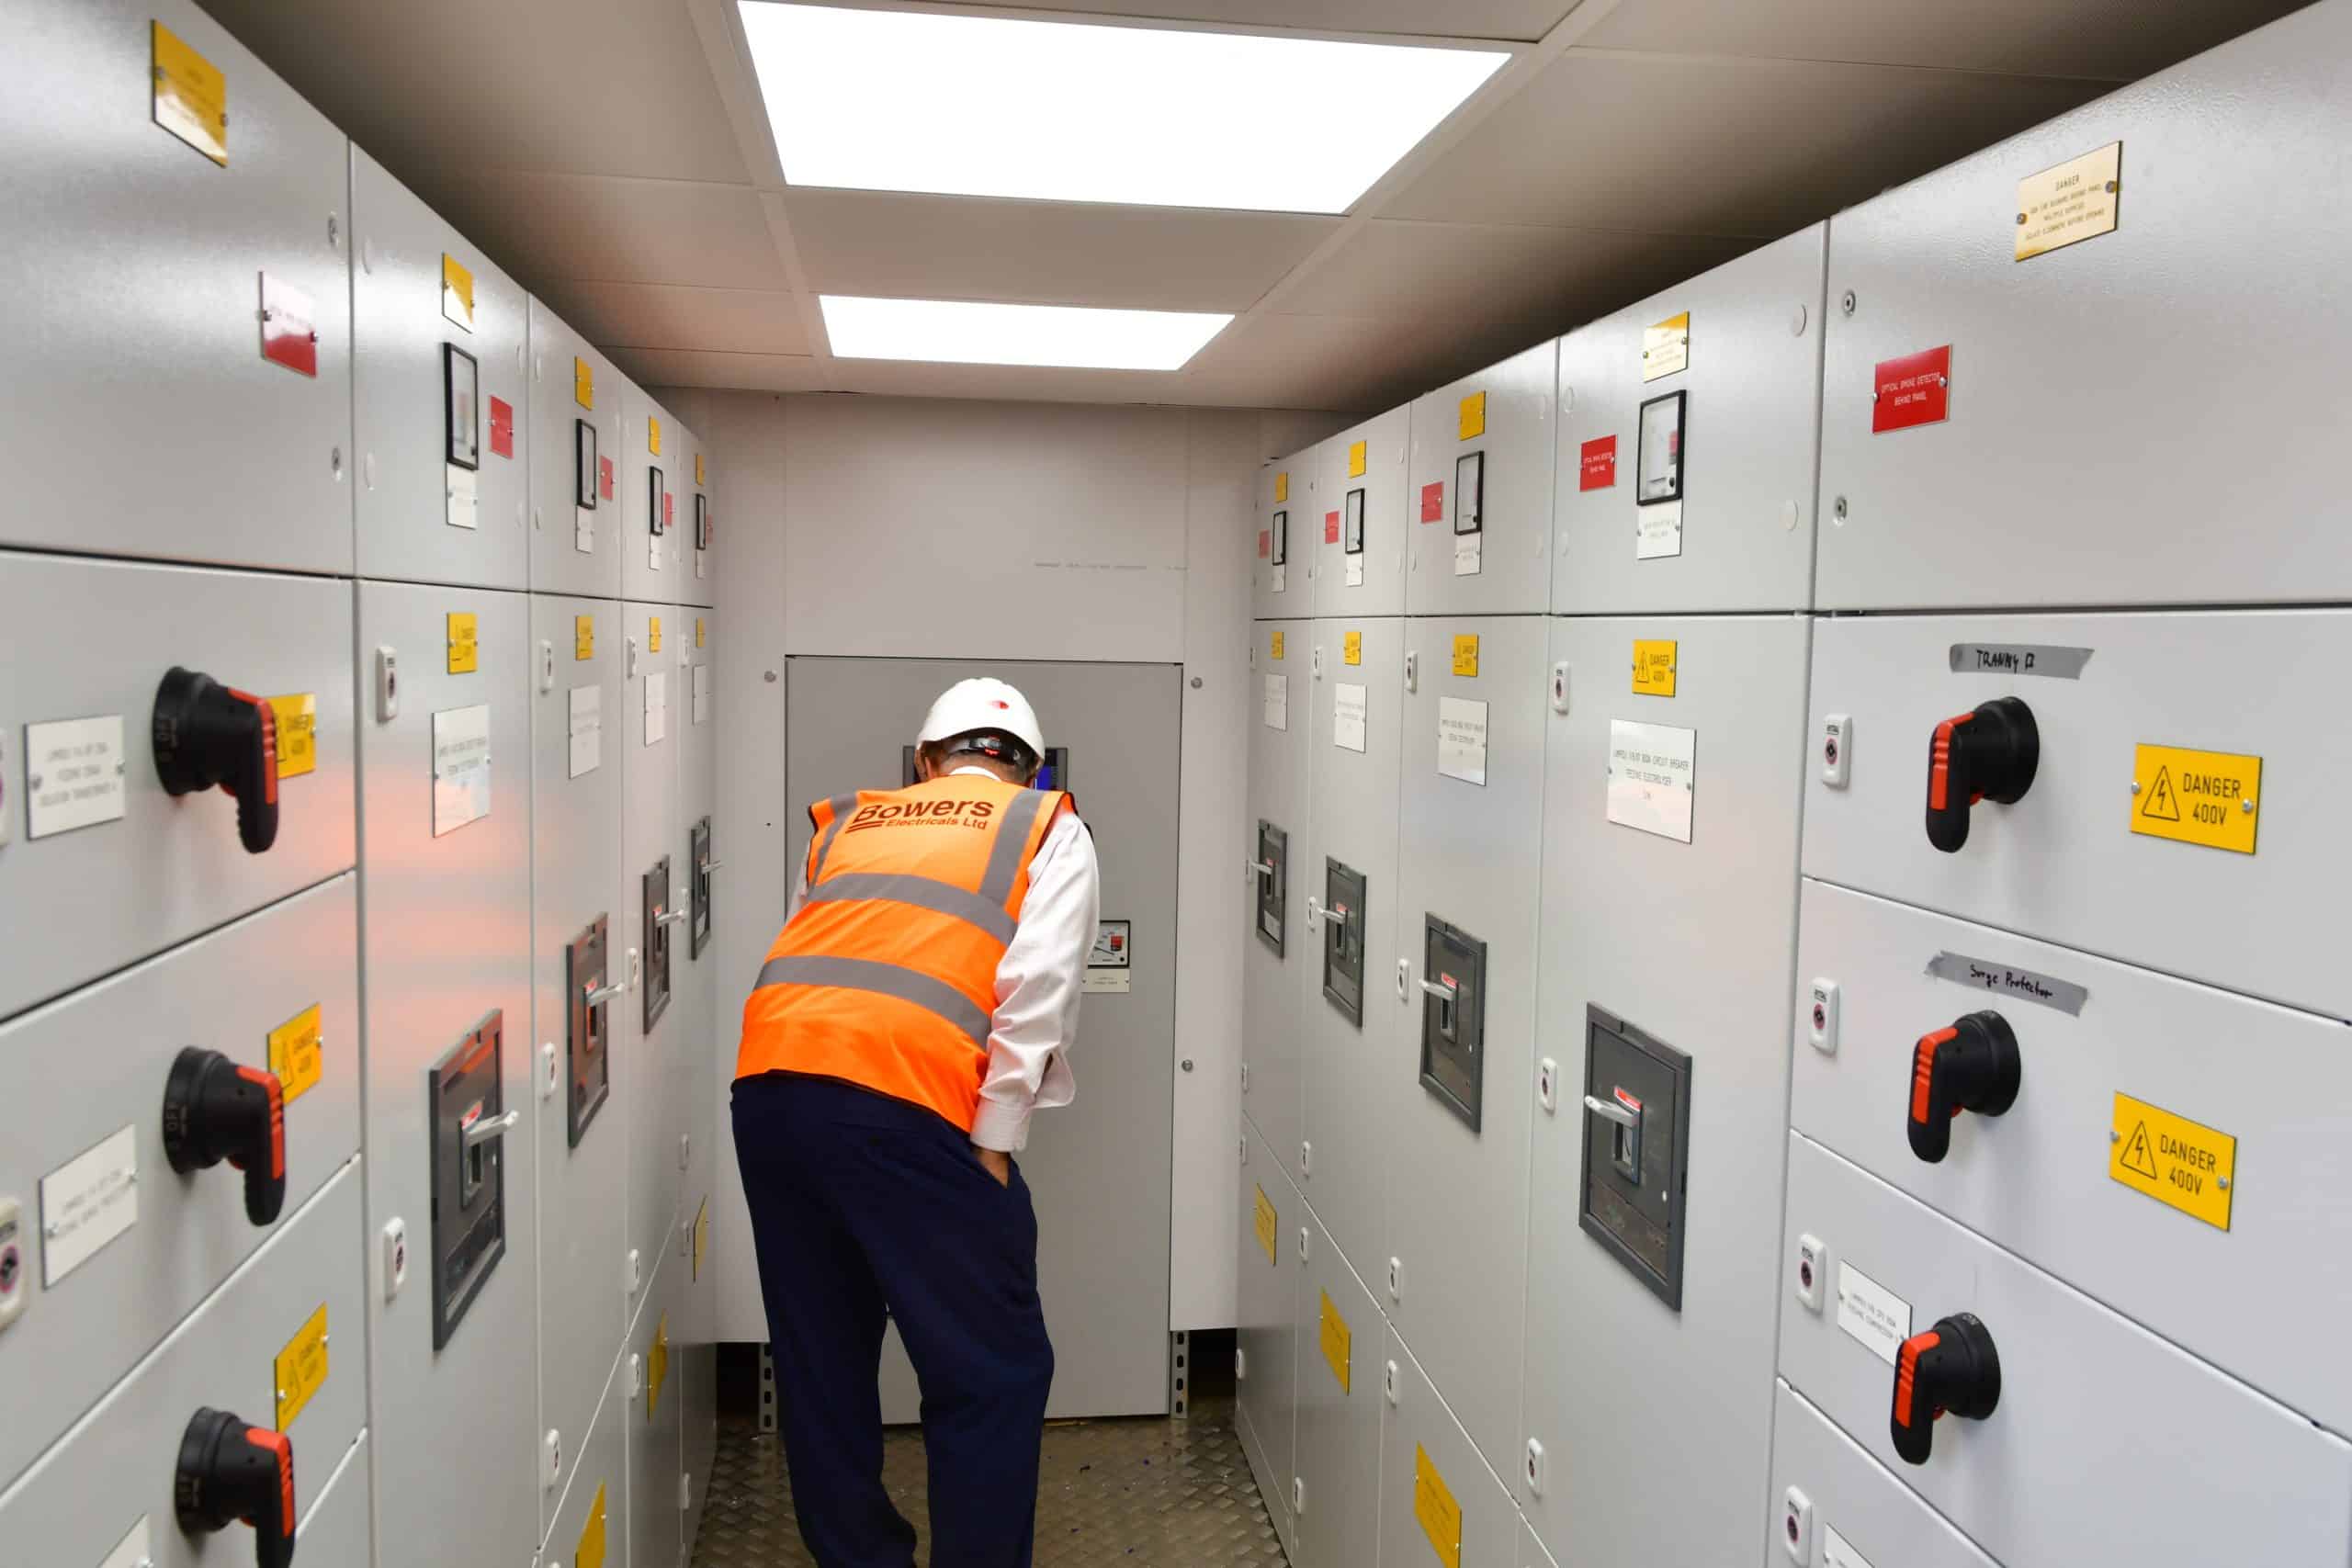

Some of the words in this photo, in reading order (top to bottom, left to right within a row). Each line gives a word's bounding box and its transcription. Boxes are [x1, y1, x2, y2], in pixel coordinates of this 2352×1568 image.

[1976, 649, 2018, 673] TRANNY
[2182, 773, 2241, 799] DANGER
[852, 800, 994, 824] Bowers
[886, 818, 958, 827] Electricals
[963, 817, 989, 830] Ltd
[2192, 803, 2227, 826] 400V
[2006, 971, 2053, 999] Protector
[2160, 1134, 2216, 1175] DANGER
[2169, 1167, 2203, 1196] 400V
